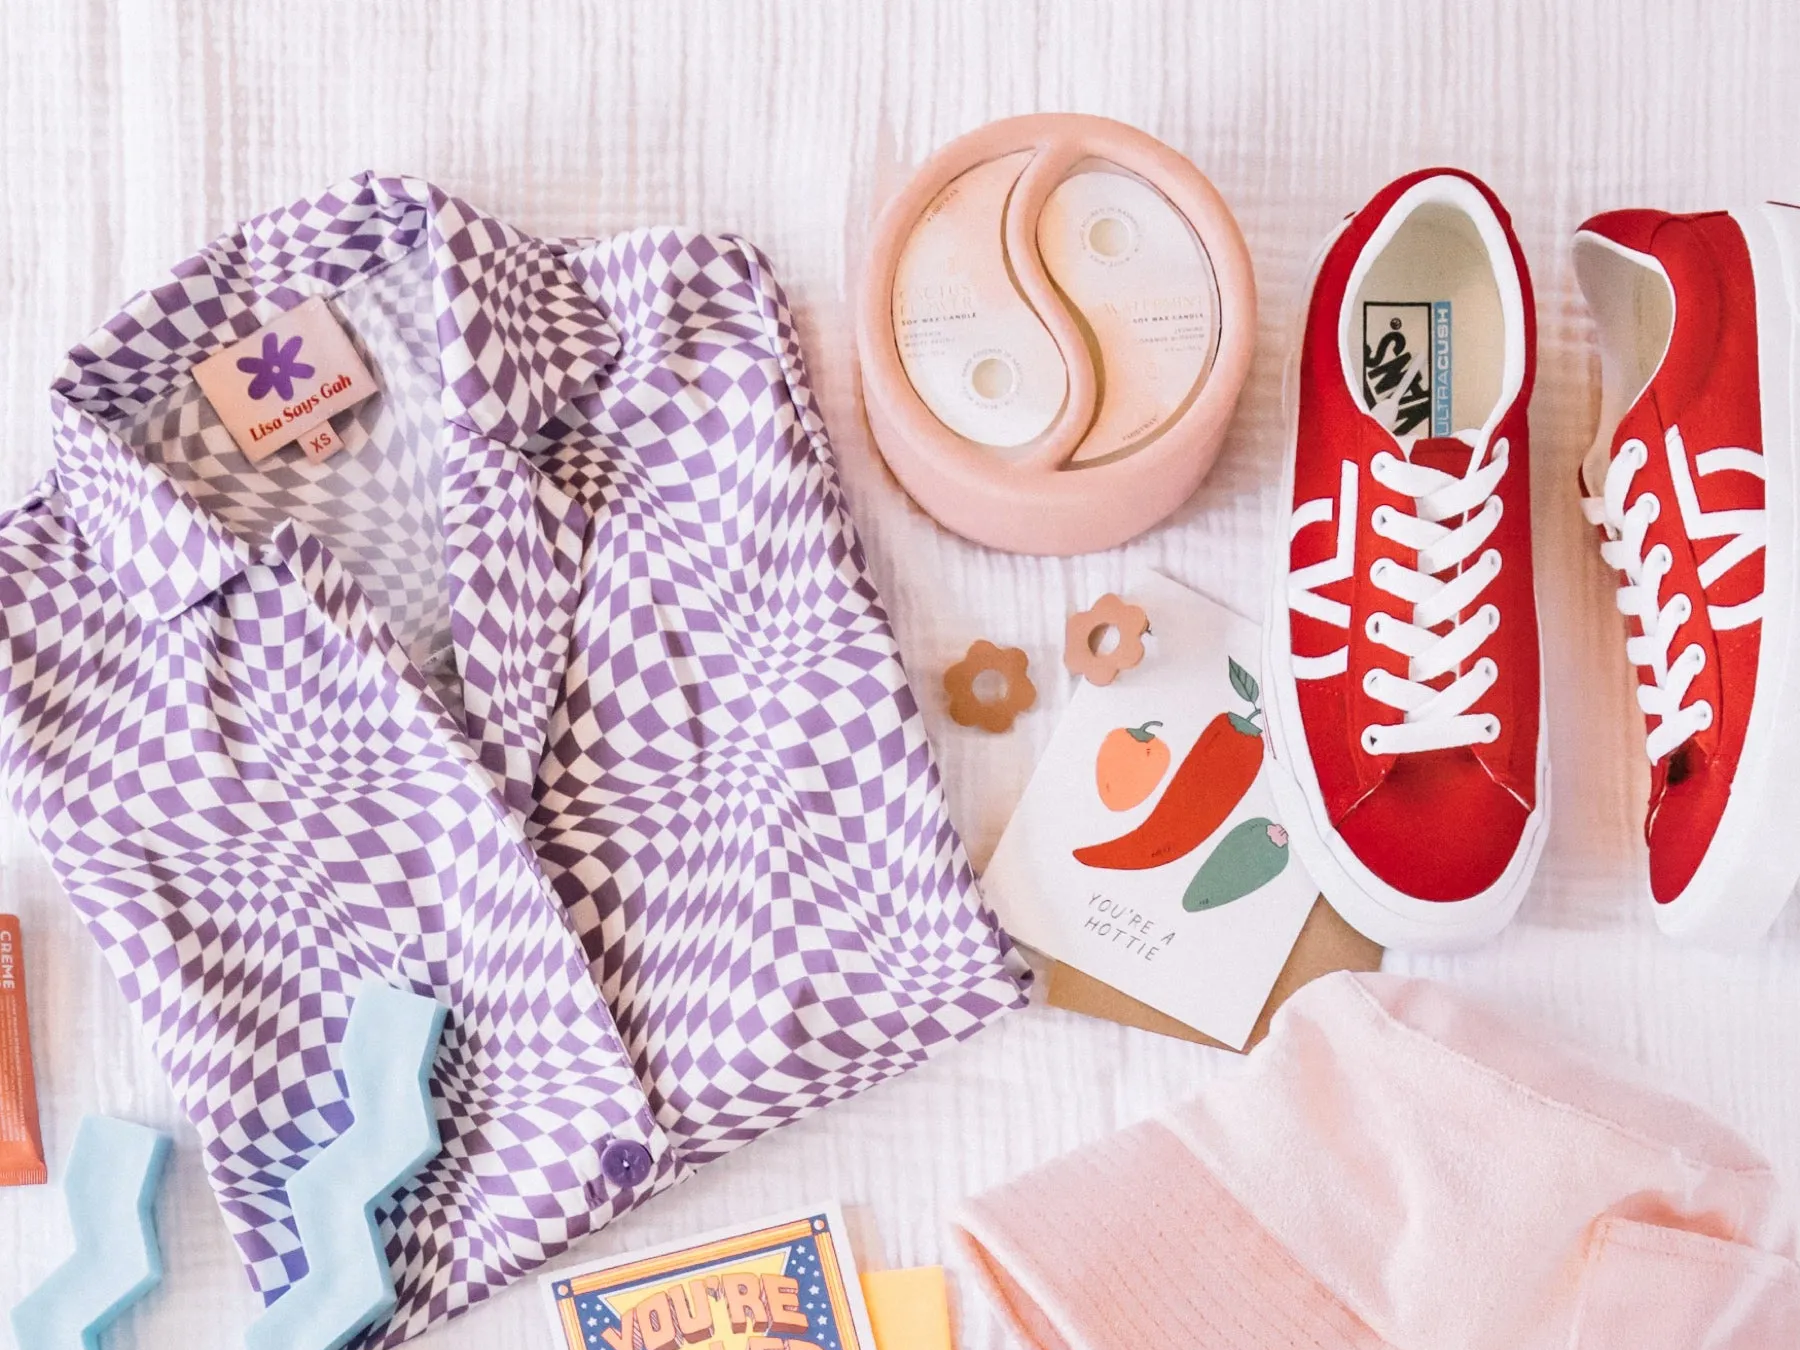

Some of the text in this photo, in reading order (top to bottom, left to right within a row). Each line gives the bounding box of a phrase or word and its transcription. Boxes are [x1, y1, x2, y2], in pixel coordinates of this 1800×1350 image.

[1437, 308, 1449, 436] ULTRACUSH
[249, 375, 352, 442] Lisa Says Gah
[310, 433, 331, 452] XS
[1084, 916, 1160, 961] HOTTIE
[1088, 893, 1176, 946] YOU'RE A
[0, 931, 15, 989] CREME
